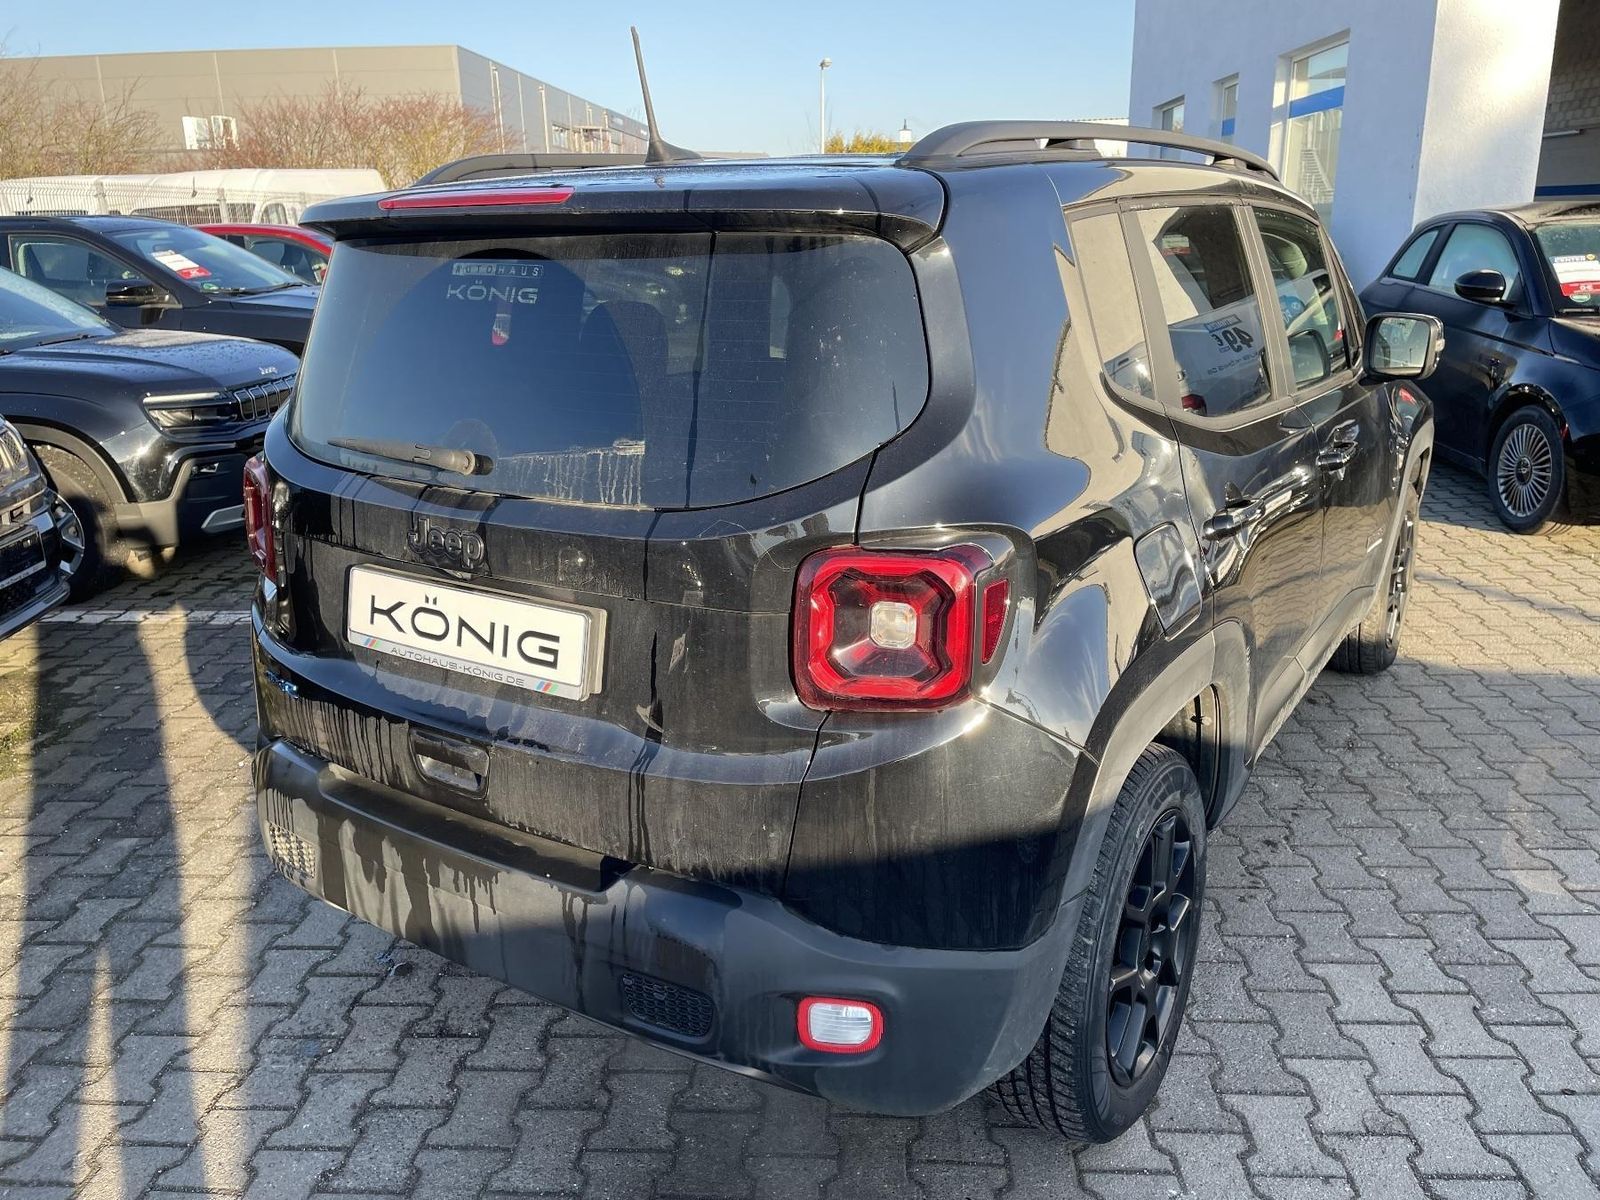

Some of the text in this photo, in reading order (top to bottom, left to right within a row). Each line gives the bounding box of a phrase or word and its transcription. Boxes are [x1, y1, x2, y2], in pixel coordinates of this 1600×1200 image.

[453, 264, 541, 276] AUTOHAUS
[446, 280, 539, 304] KÖNIG
[407, 516, 485, 569] Jeep
[369, 594, 560, 670] KÖNIG
